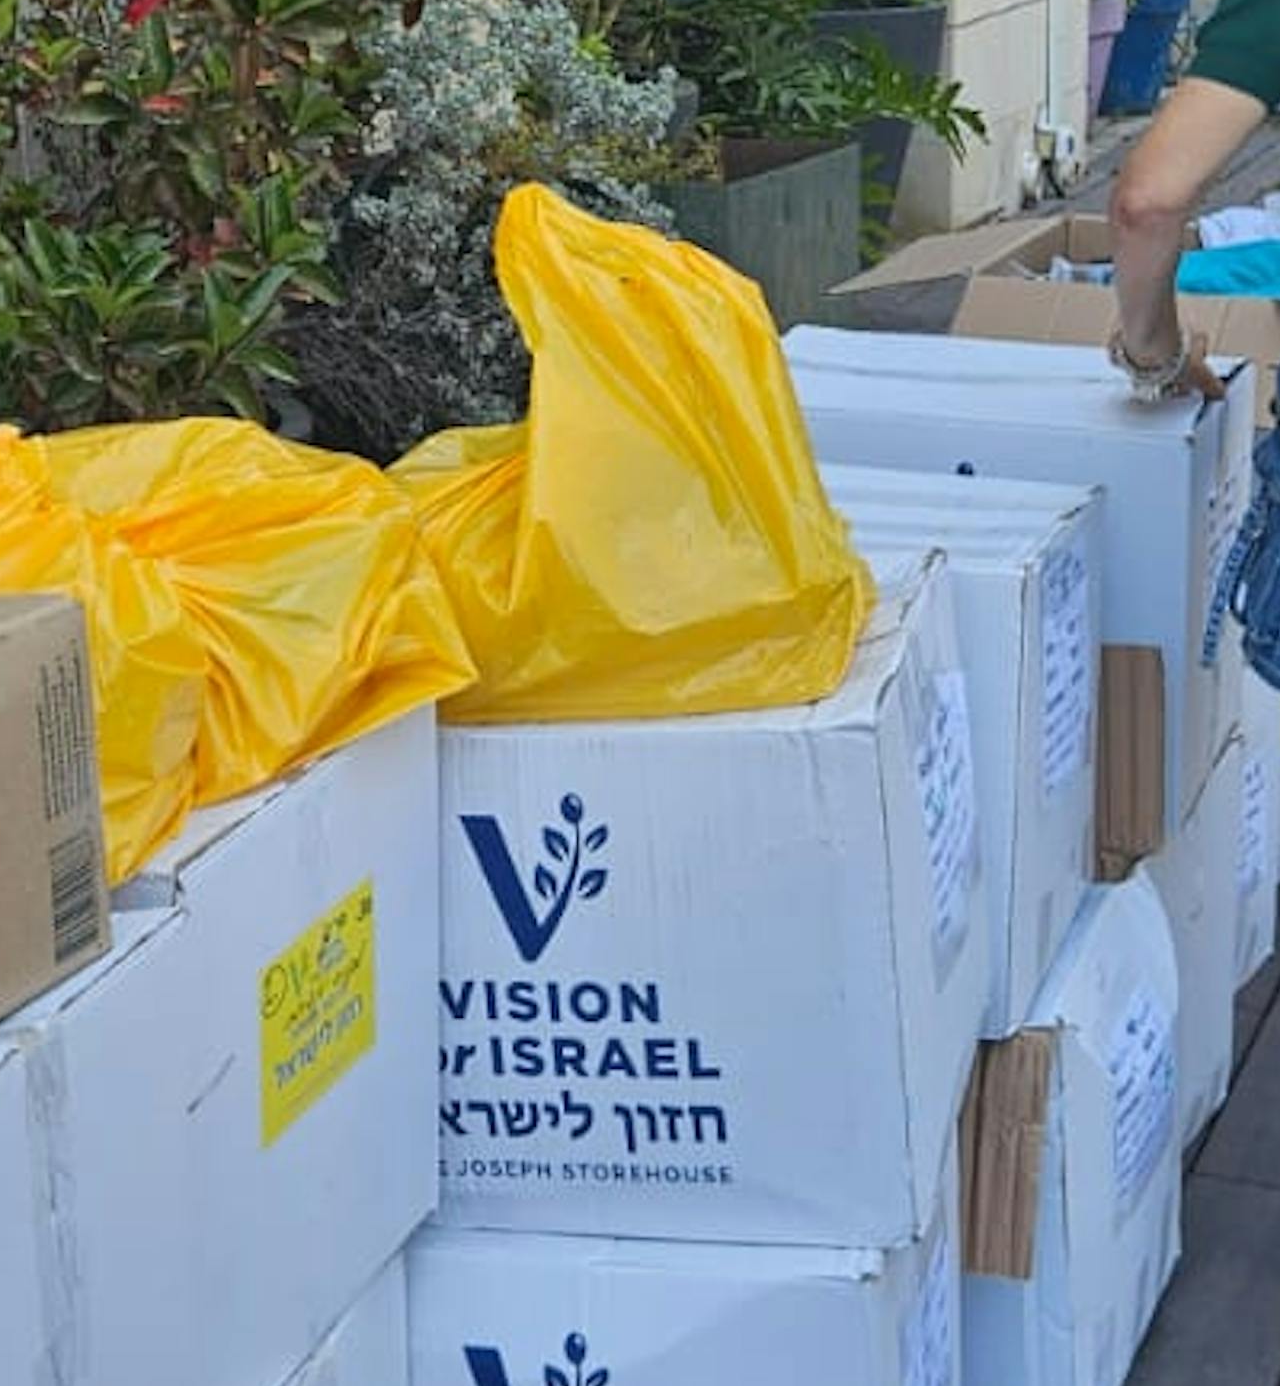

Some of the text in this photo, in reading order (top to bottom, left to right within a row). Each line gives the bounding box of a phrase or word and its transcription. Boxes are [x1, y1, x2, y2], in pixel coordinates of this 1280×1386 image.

[440, 980, 659, 1024] VISION
[489, 1036, 721, 1079] ISRAEL
[440, 1090, 727, 1153] חזון לישרא
[456, 1159, 552, 1179] JOSEPH
[562, 1163, 733, 1184] STOREHOUSE
